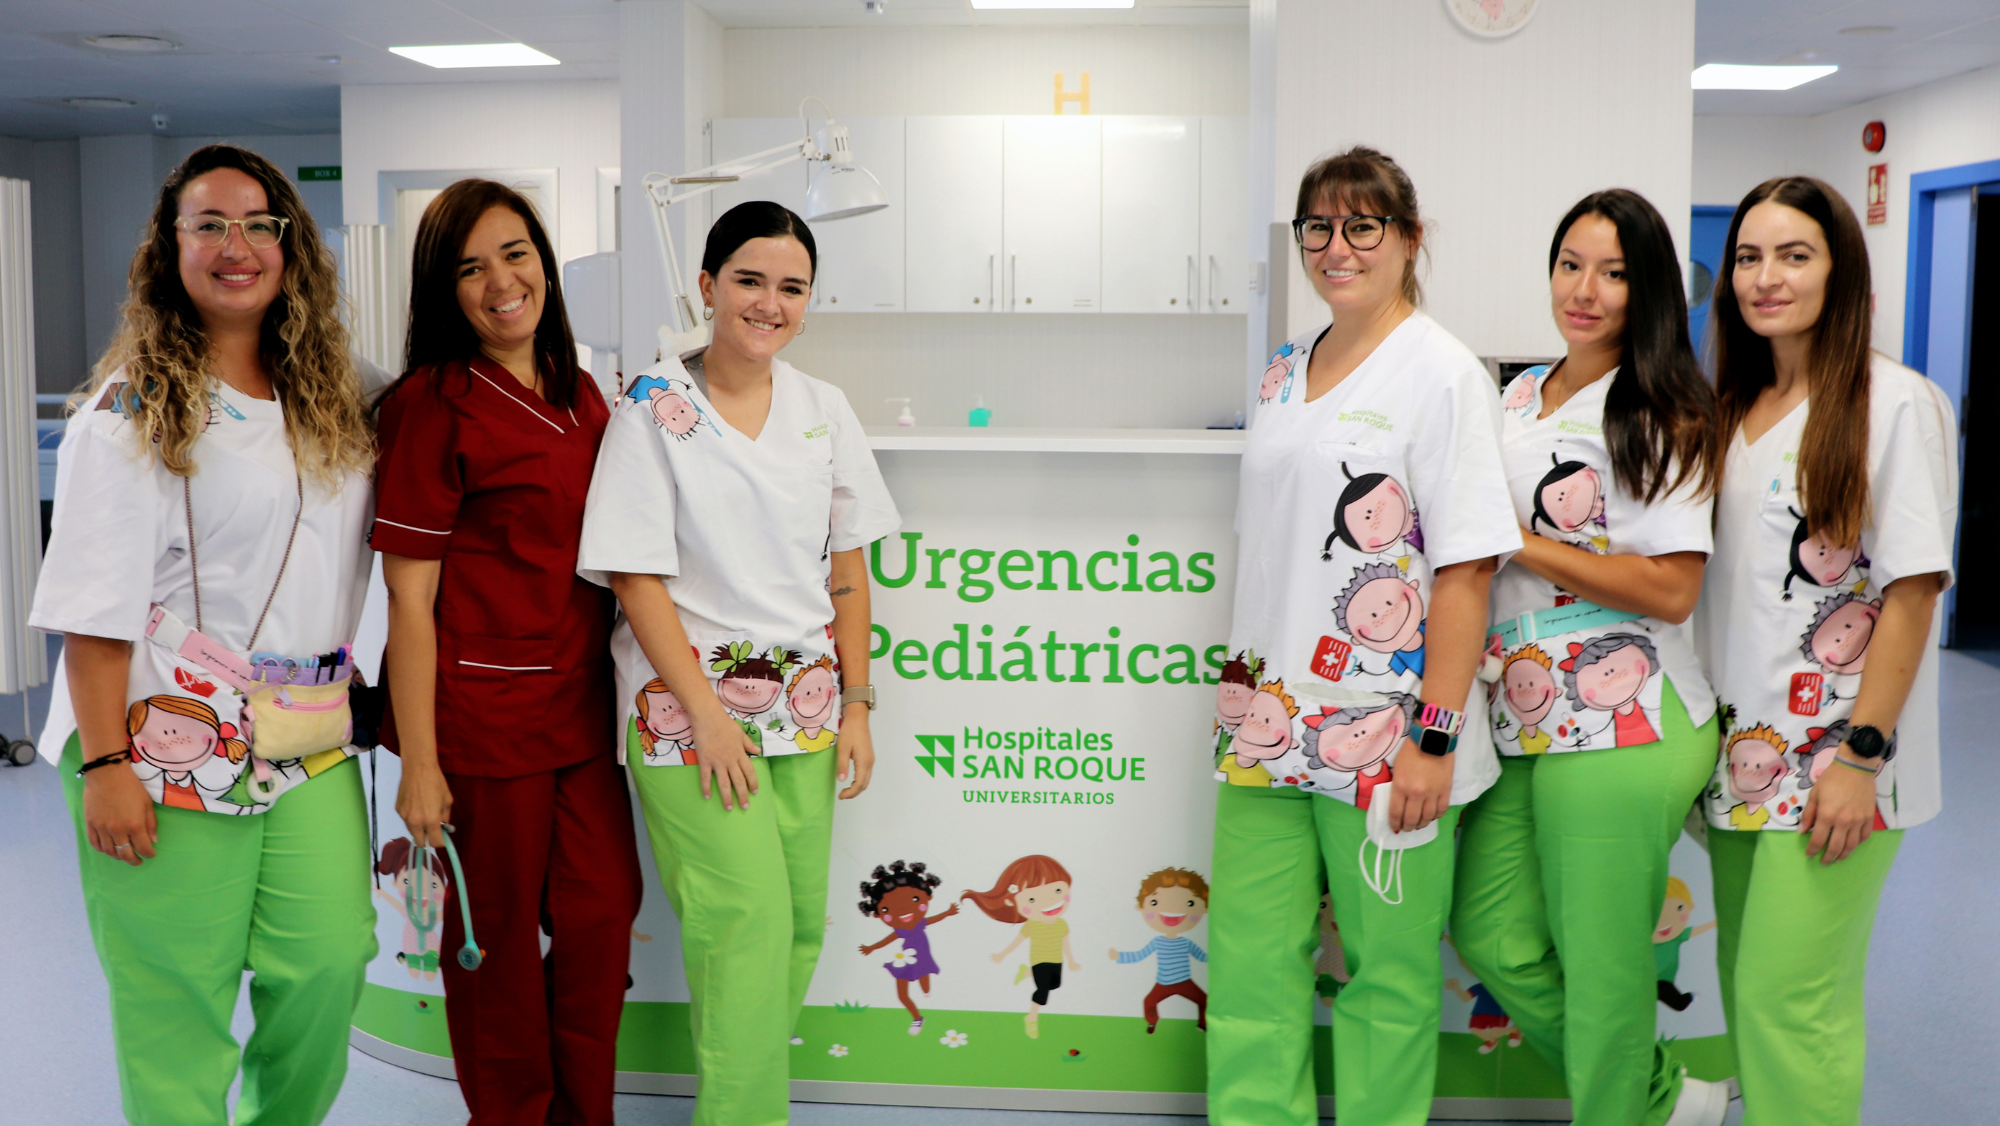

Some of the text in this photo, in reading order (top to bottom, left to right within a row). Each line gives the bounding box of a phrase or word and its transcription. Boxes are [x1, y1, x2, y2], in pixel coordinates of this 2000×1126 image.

[1054, 72, 1091, 115] H
[870, 532, 1216, 603] Urgencias
[963, 725, 1114, 757] Hospitales
[962, 754, 1146, 783] SAN ROQUE
[962, 790, 1115, 805] UNIVERSITARIOS
